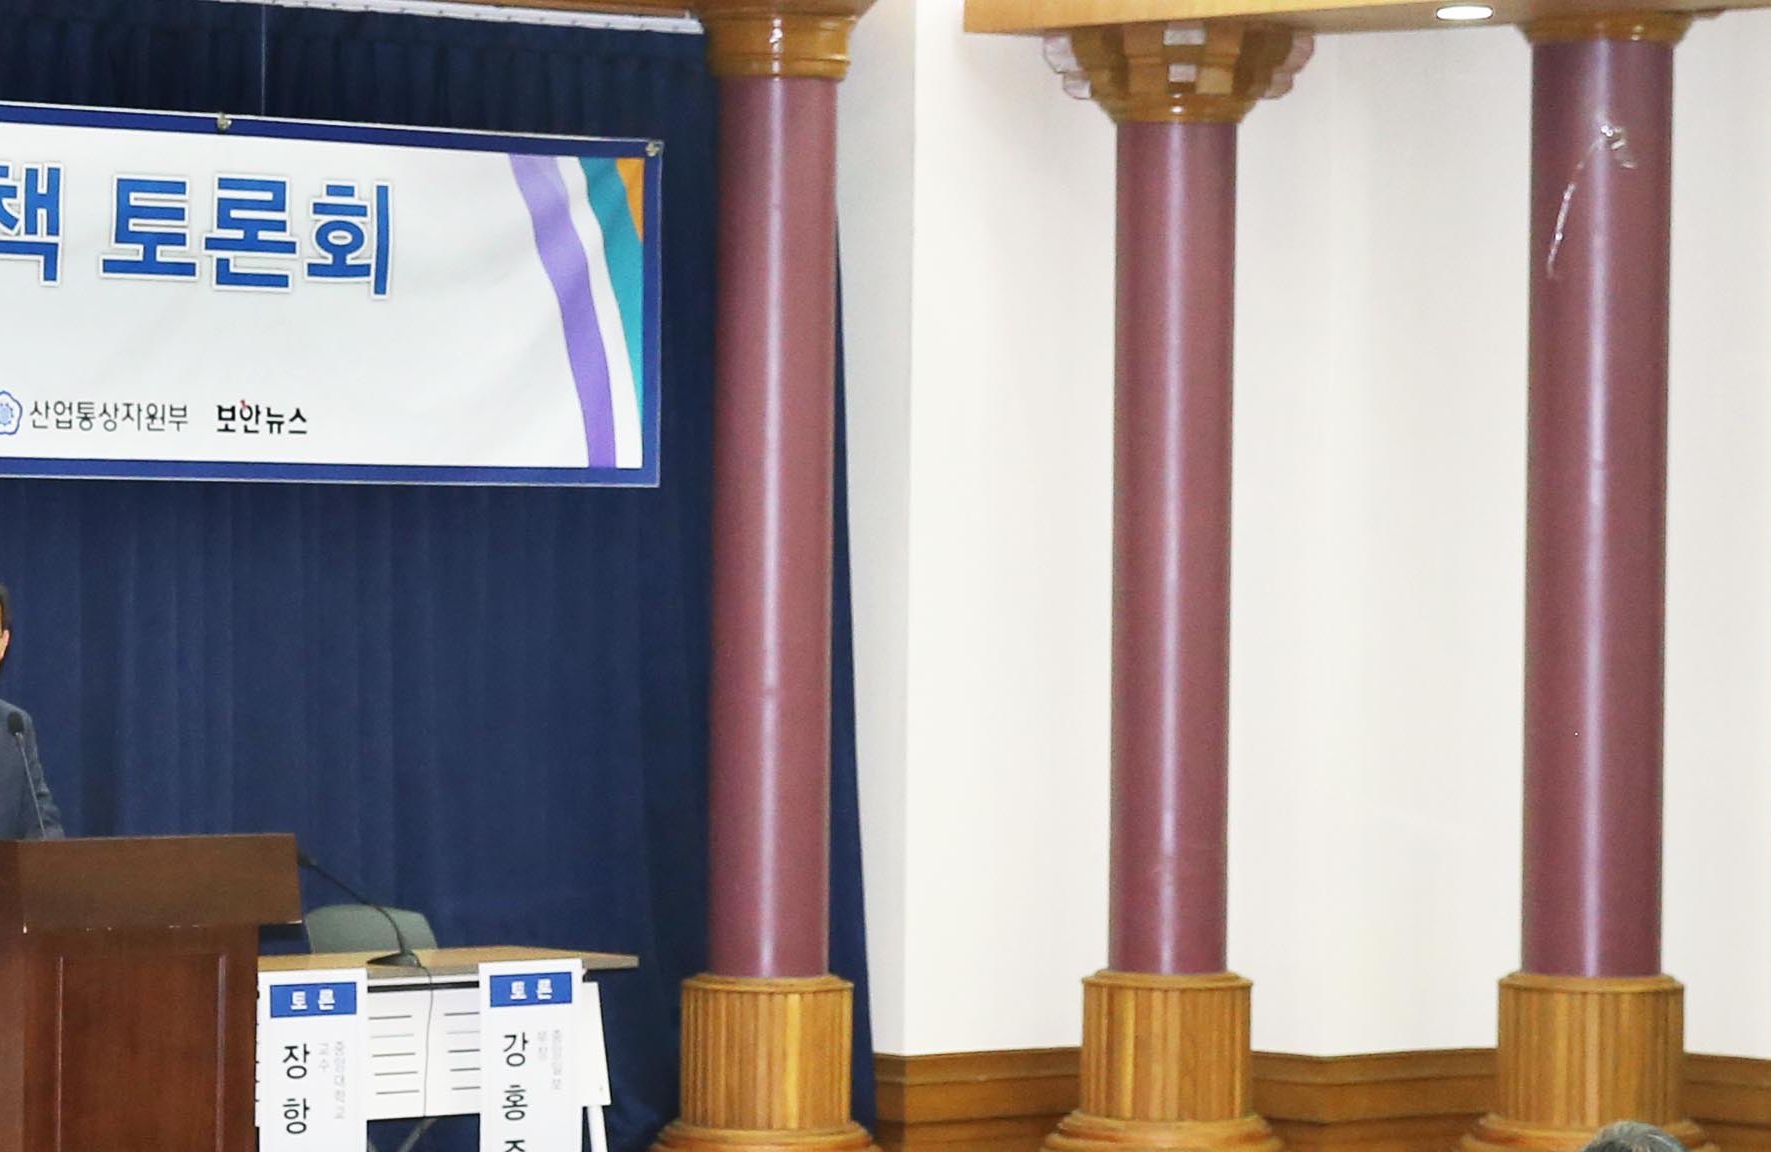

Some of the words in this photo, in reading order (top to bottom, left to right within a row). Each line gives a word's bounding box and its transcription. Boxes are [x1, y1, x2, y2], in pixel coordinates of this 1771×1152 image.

[102, 177, 391, 297] 토론회
[28, 400, 189, 433] 산업통상자원부
[216, 399, 307, 435] 보안뉴스
